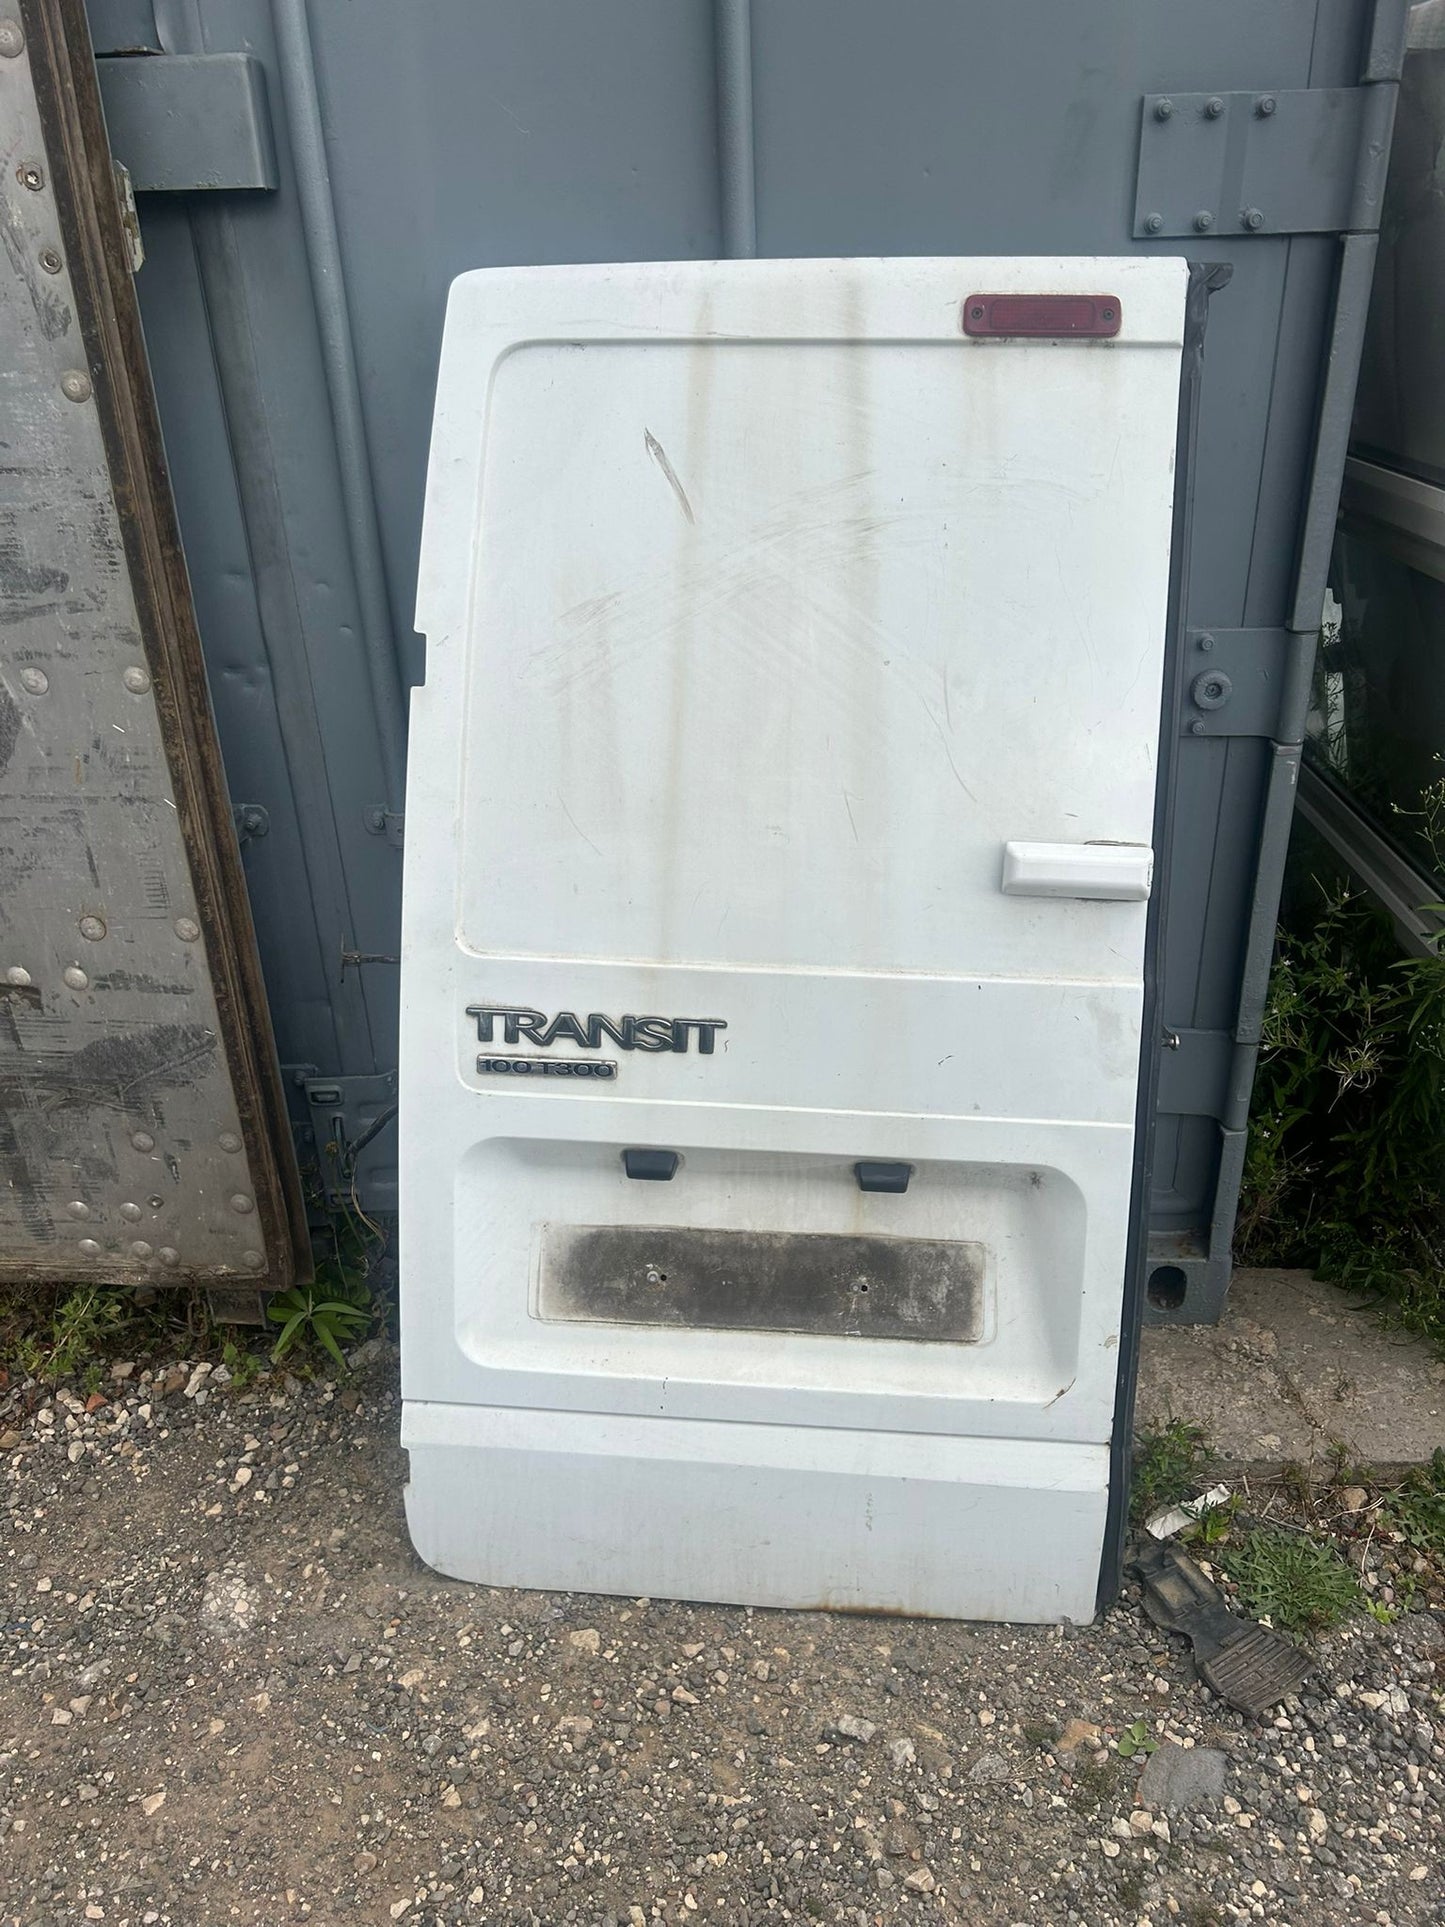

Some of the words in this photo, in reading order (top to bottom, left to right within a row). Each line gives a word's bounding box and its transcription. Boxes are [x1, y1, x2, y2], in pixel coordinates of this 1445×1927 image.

[466, 1006, 727, 1054] TRANSIT
[479, 1059, 532, 1073] 100
[537, 1061, 614, 1077] T300
